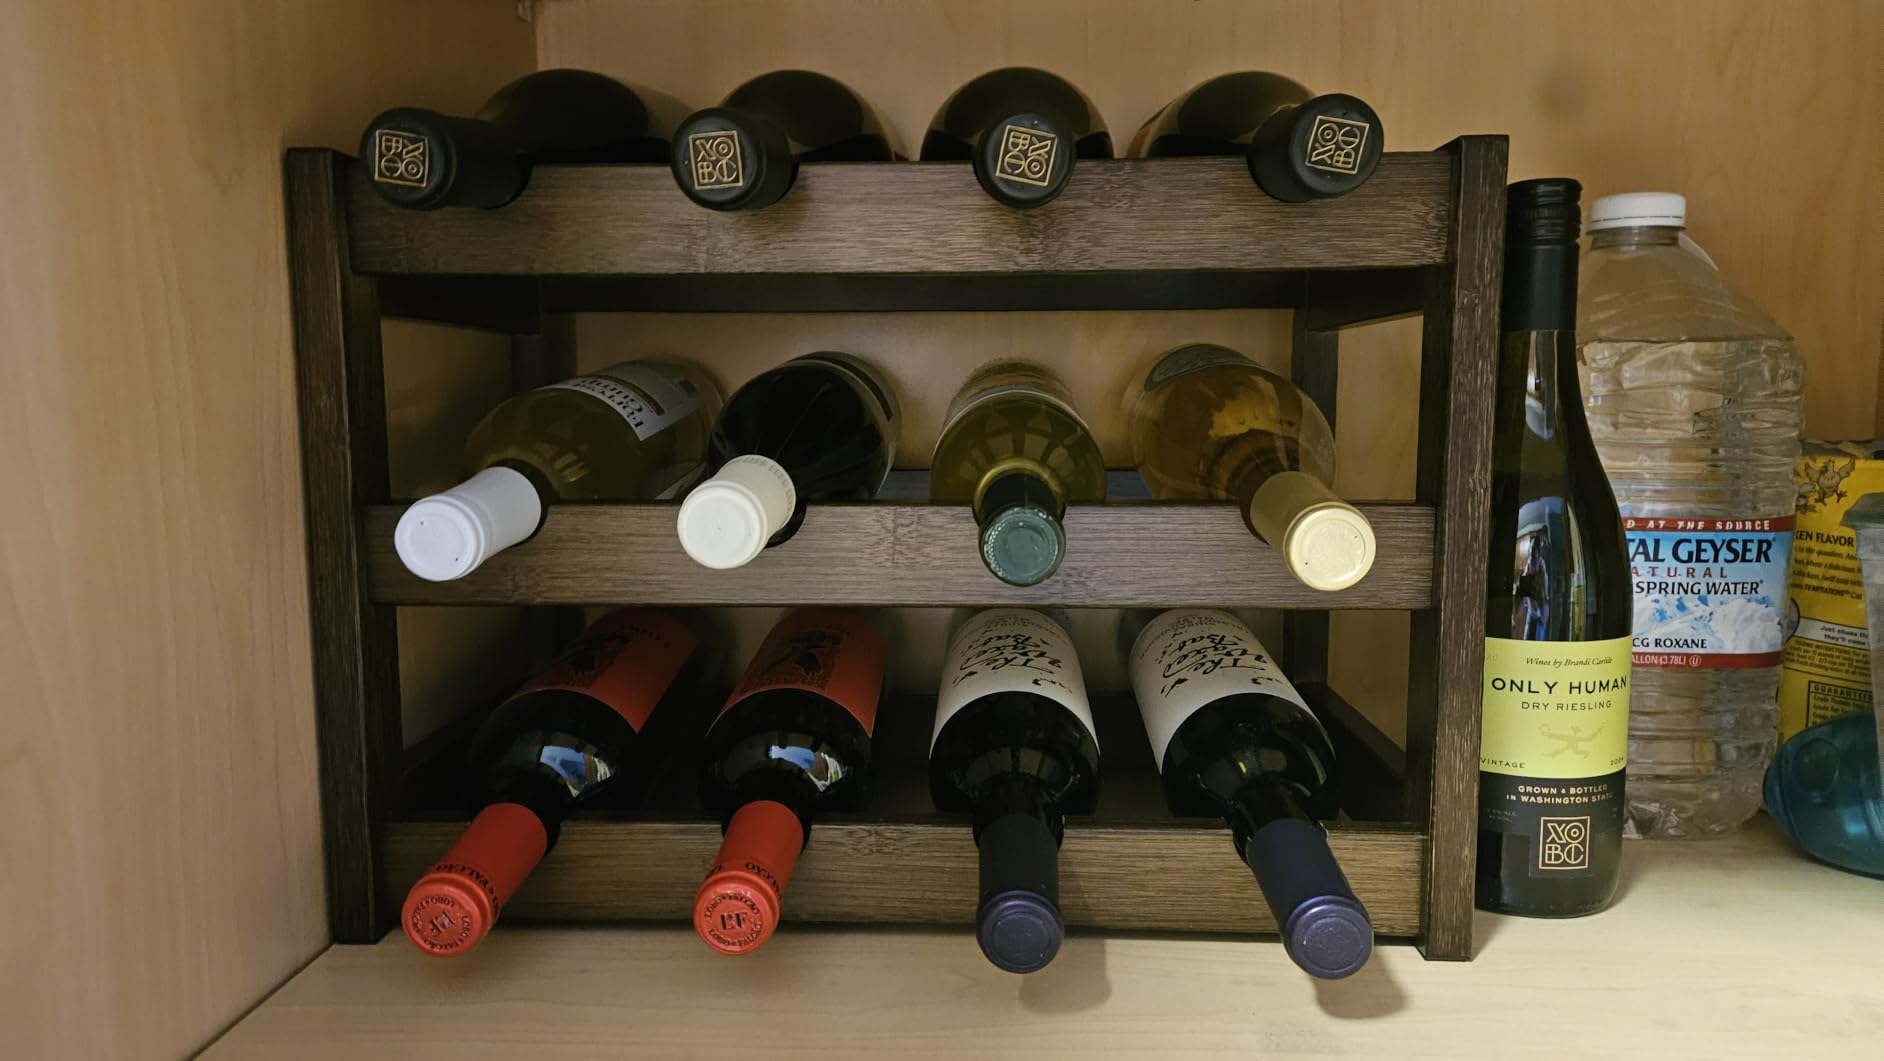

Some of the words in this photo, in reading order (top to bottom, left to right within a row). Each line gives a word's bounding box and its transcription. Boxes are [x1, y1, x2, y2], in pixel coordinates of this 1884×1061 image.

[1647, 520, 1666, 528] AT
[1677, 520, 1705, 530] THE
[1716, 520, 1770, 530] SOURCE
[1816, 532, 1854, 548] FLAVOR
[1635, 580, 1700, 596] SPRING
[1654, 638, 1708, 648] ROXANE
[986, 656, 1055, 674] The
[1188, 658, 1266, 675] The
[1526, 658, 1550, 666] Wines
[1553, 658, 1562, 668] by
[1564, 658, 1590, 666] Brandi
[1492, 678, 1558, 695] ONLY
[1569, 674, 1627, 695] HUMAN
[1522, 701, 1550, 710] DRY
[1556, 700, 1612, 712] RIESLING
[1480, 758, 1526, 769] VINTAGE
[1518, 785, 1558, 794] GROWN
[1570, 784, 1608, 794] BOTTLED
[1520, 794, 1589, 804] WASHINGTON
